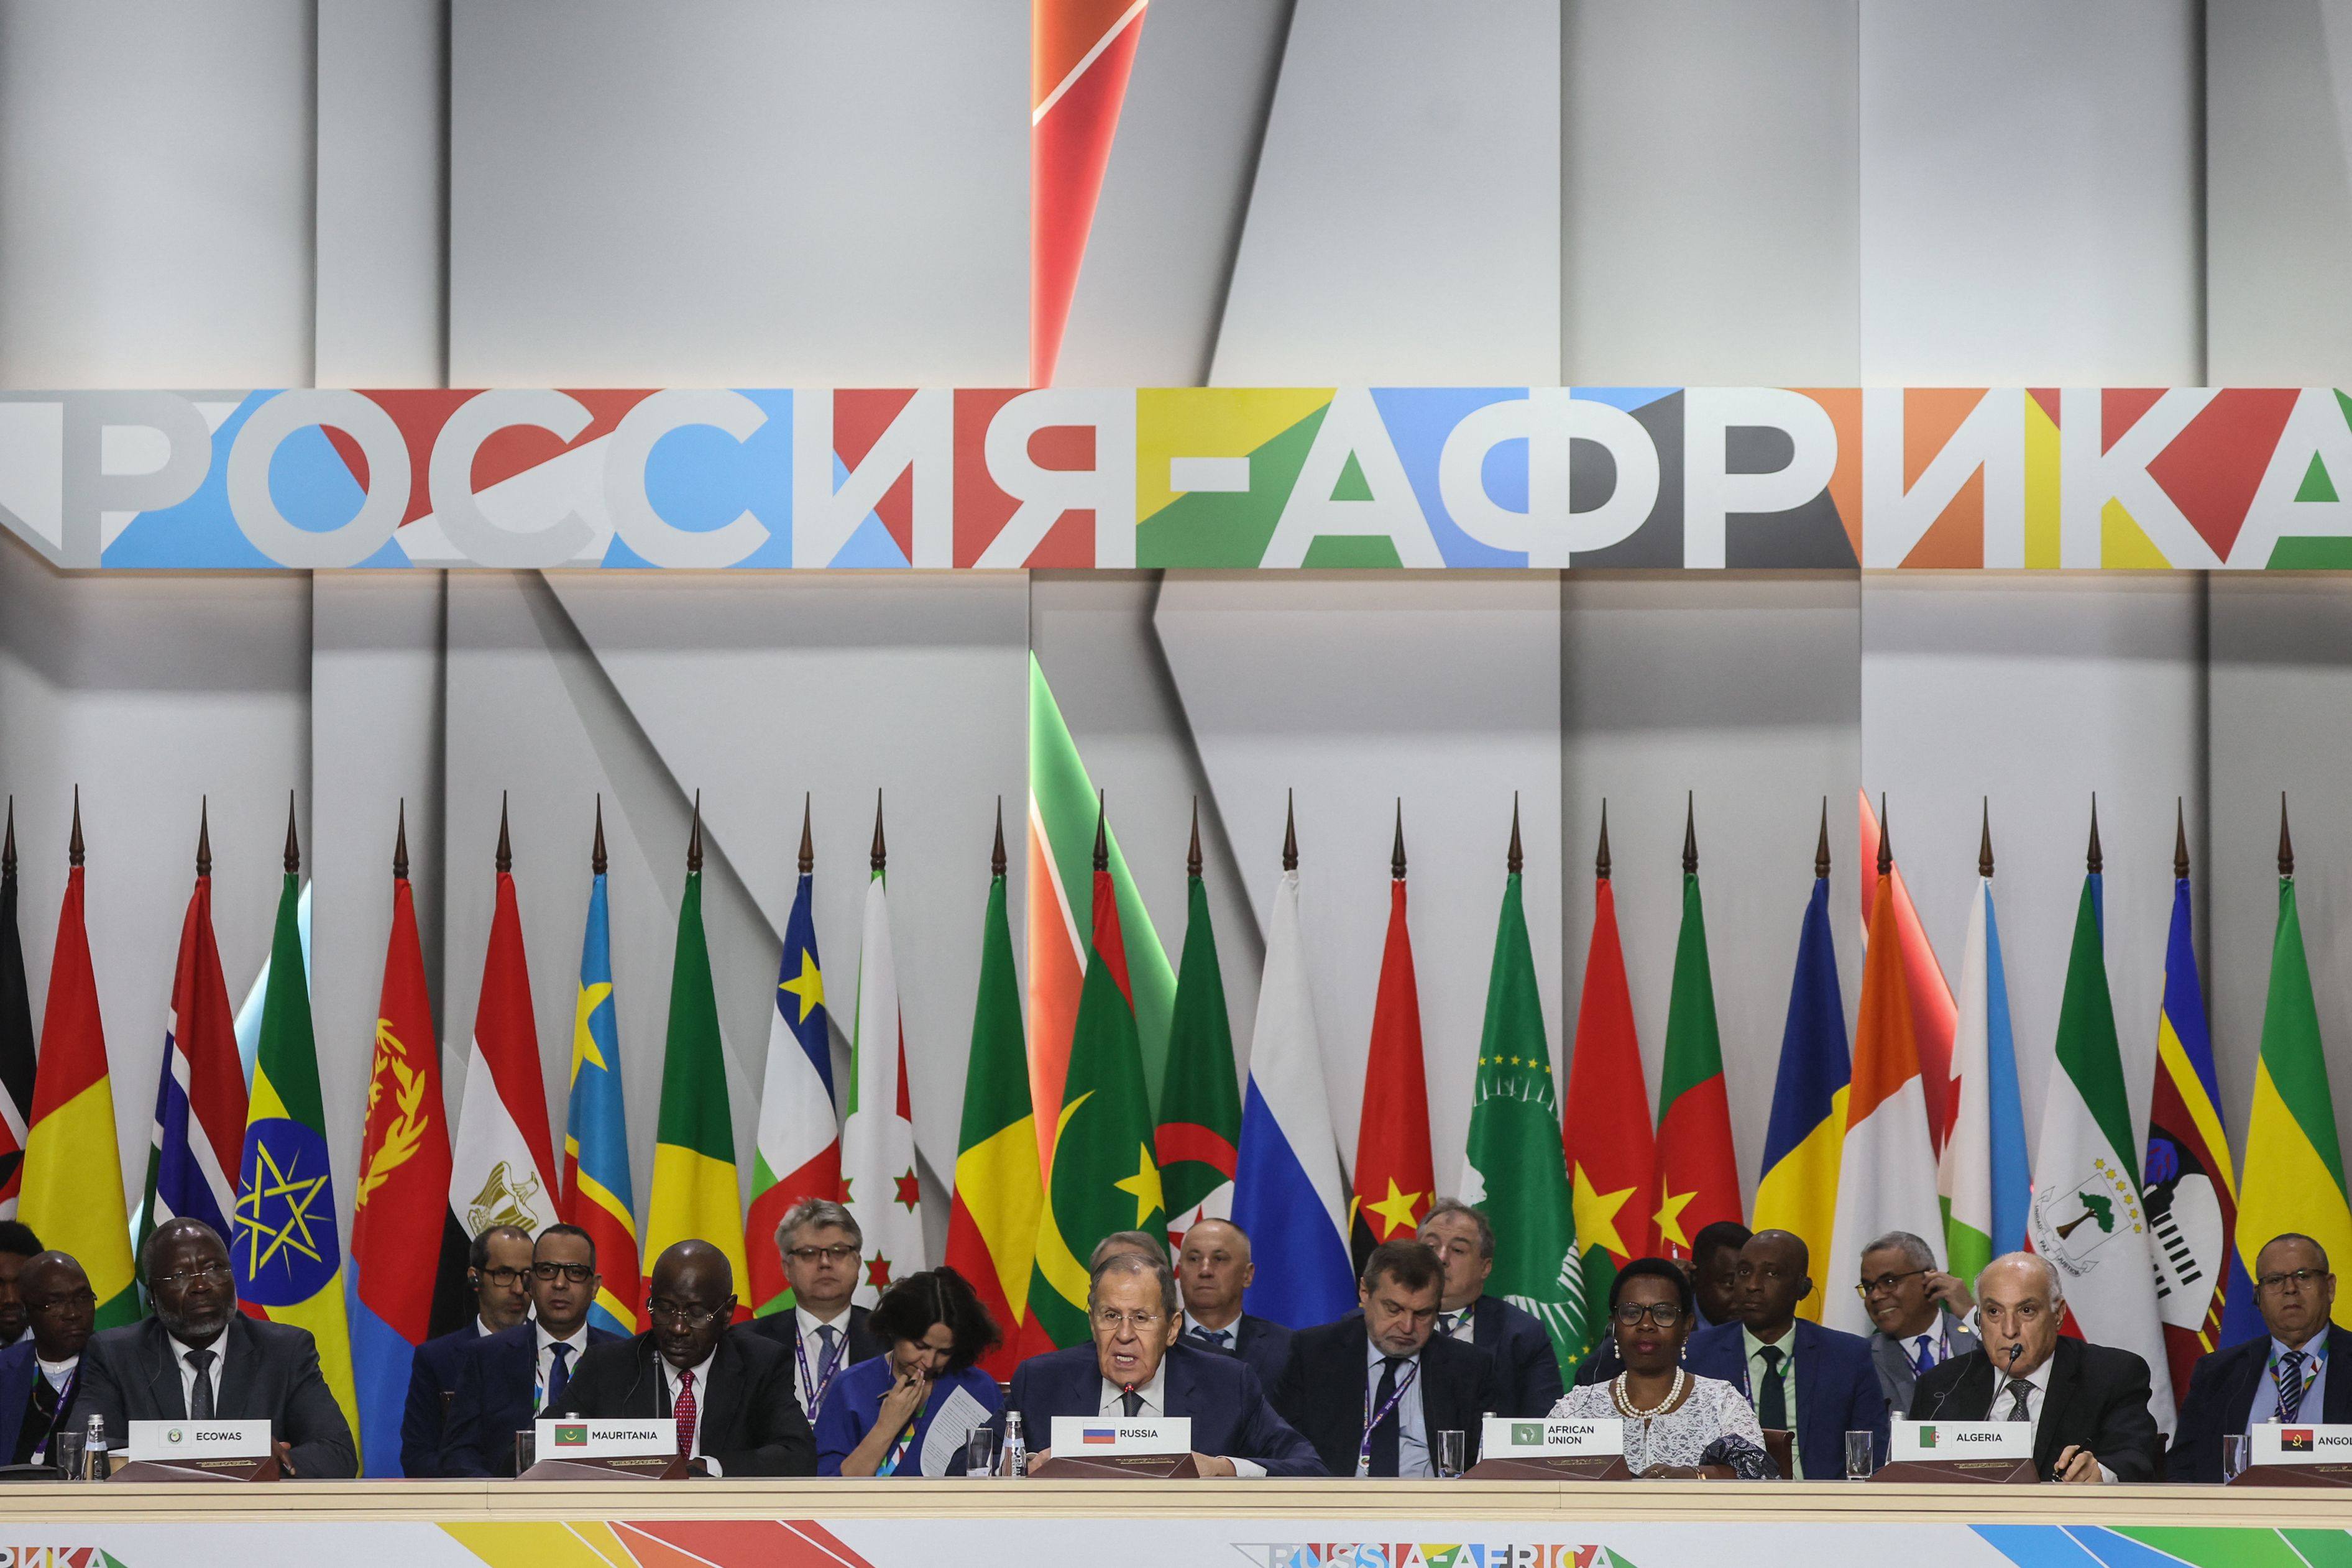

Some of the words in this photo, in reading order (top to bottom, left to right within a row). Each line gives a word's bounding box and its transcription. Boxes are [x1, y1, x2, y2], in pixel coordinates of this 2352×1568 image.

[62, 388, 2352, 569] РОССИЯ-АФРИКА
[2039, 1239, 2050, 1252] PAZ
[1120, 1429, 1159, 1437] RUSSIA
[1548, 1426, 1594, 1434] AFRICAN
[196, 1432, 242, 1441] ECOWAS
[592, 1431, 658, 1439] MAURITANIA
[1956, 1433, 2003, 1442] ALGERIA
[1548, 1436, 1582, 1444] UNION
[1268, 1543, 1617, 1568] RUSSIA-AFRICA
